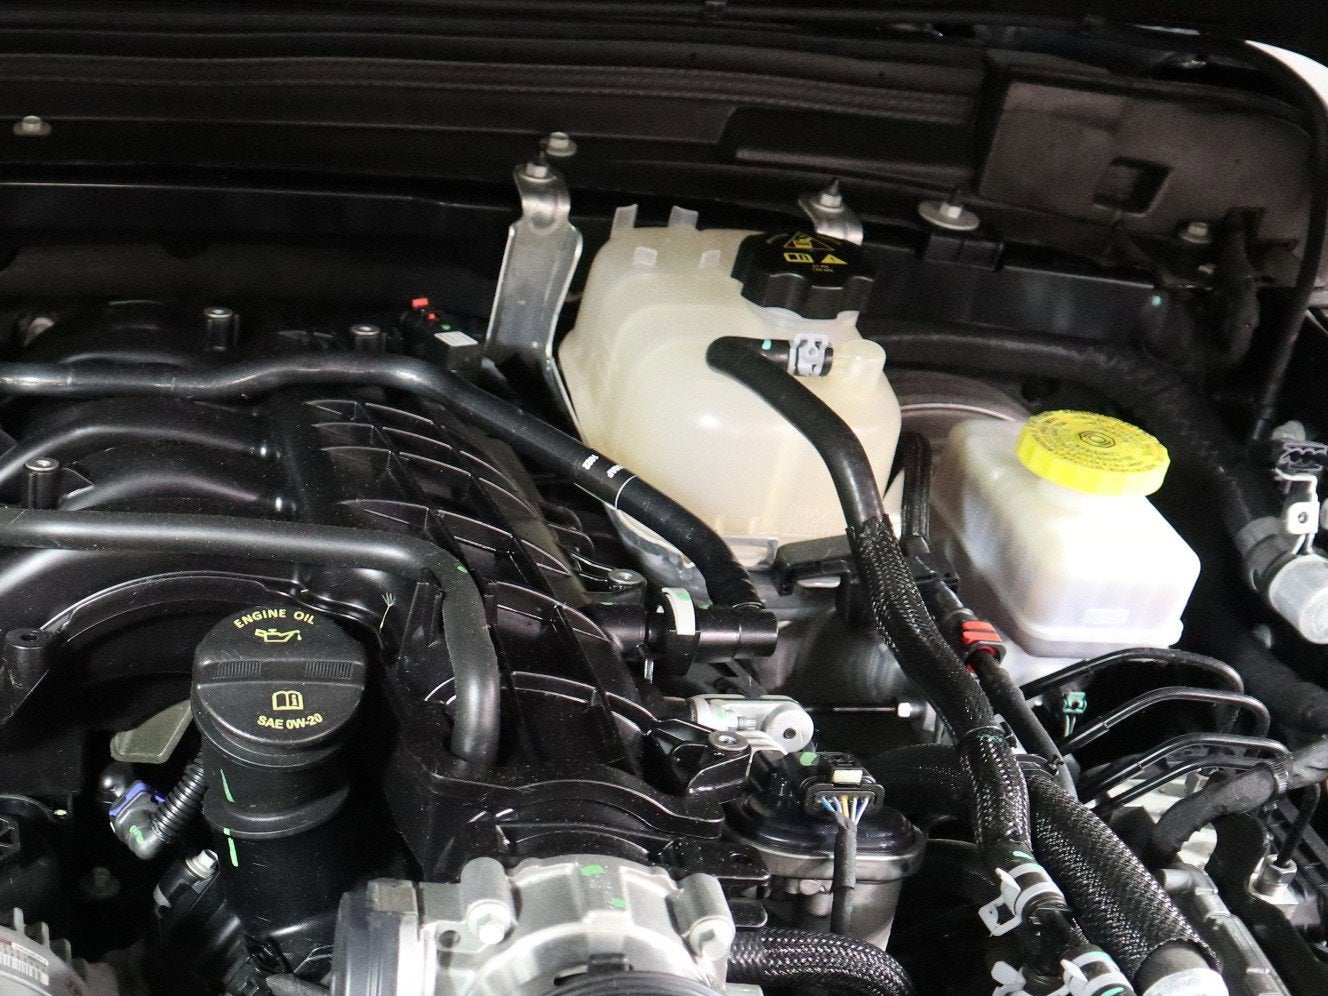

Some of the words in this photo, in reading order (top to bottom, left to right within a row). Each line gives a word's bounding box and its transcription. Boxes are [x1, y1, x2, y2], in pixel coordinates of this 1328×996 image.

[233, 609, 286, 629] ENGINE
[293, 611, 314, 624] OIL
[257, 715, 283, 729] SAE
[286, 713, 323, 729] 0W-20
